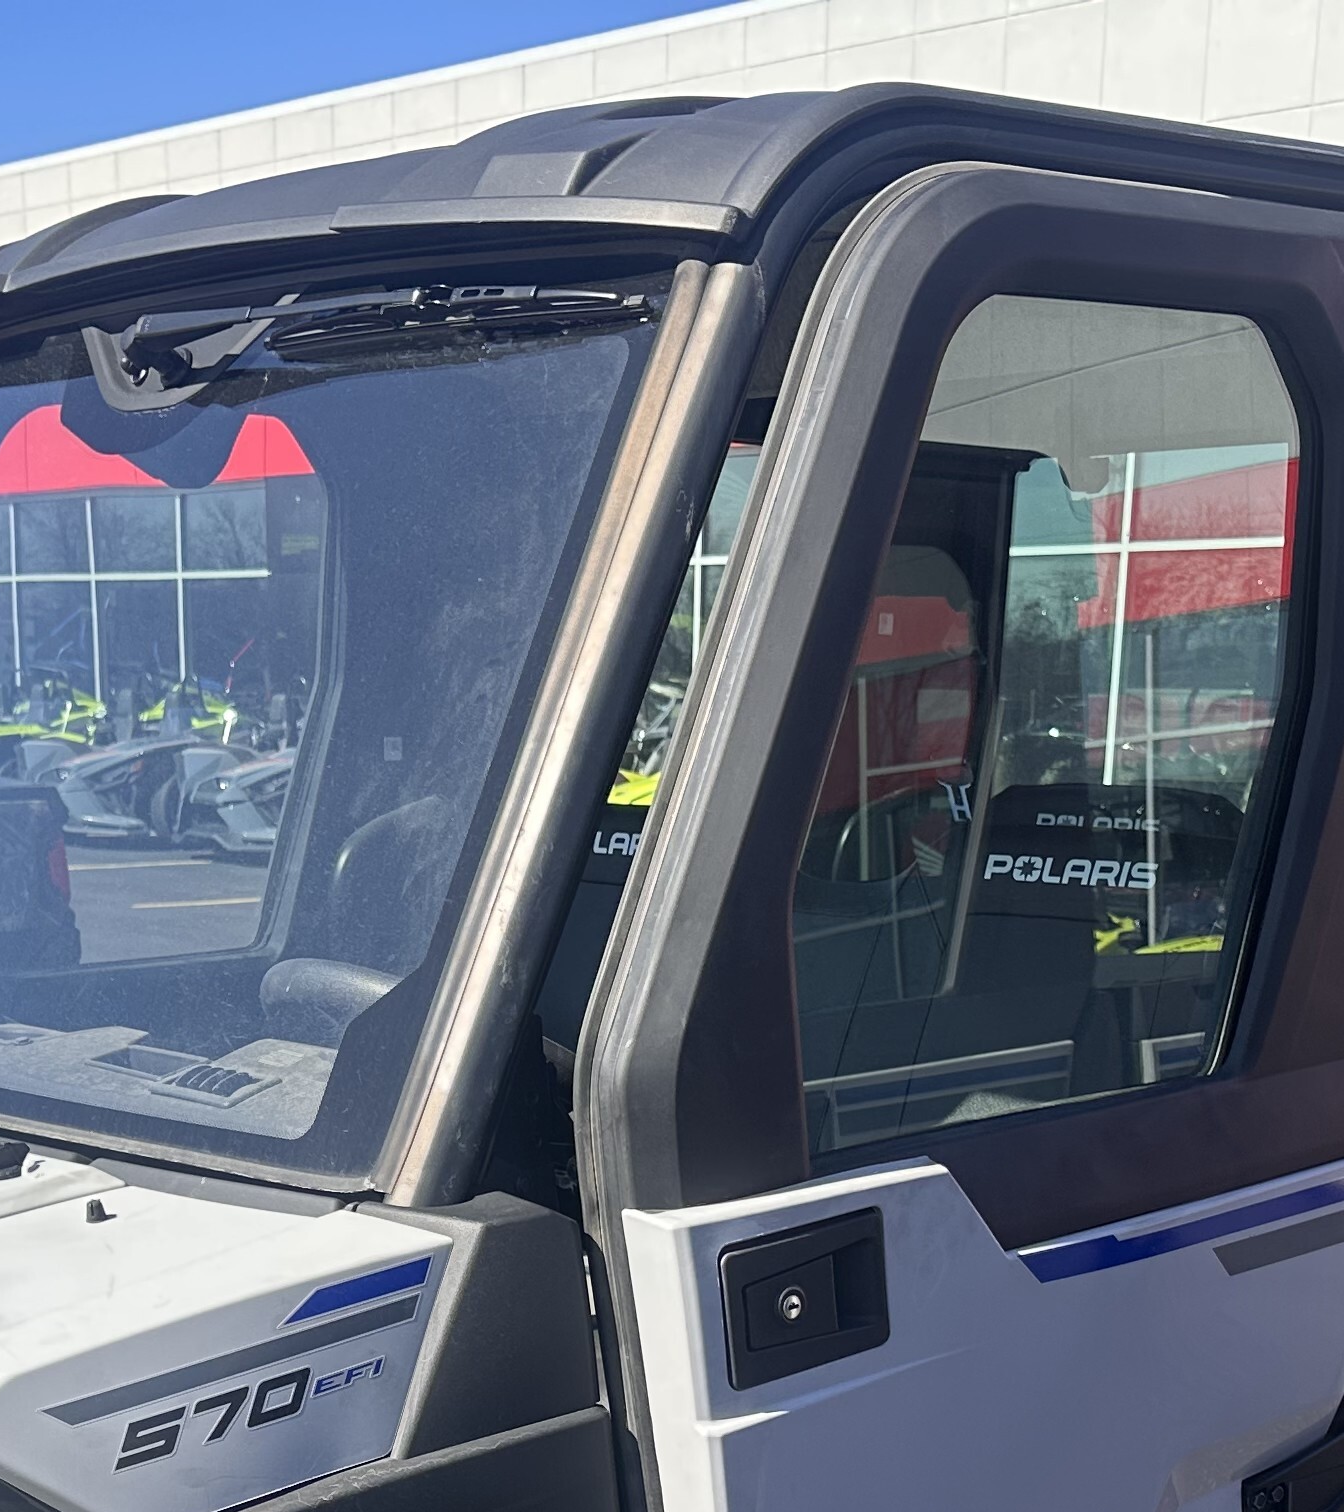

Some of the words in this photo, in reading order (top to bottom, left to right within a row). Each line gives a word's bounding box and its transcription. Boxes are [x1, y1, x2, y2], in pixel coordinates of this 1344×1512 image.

[983, 853, 1159, 889] POLARIS
[113, 1367, 311, 1474] 570
[312, 1356, 386, 1398] EFI
